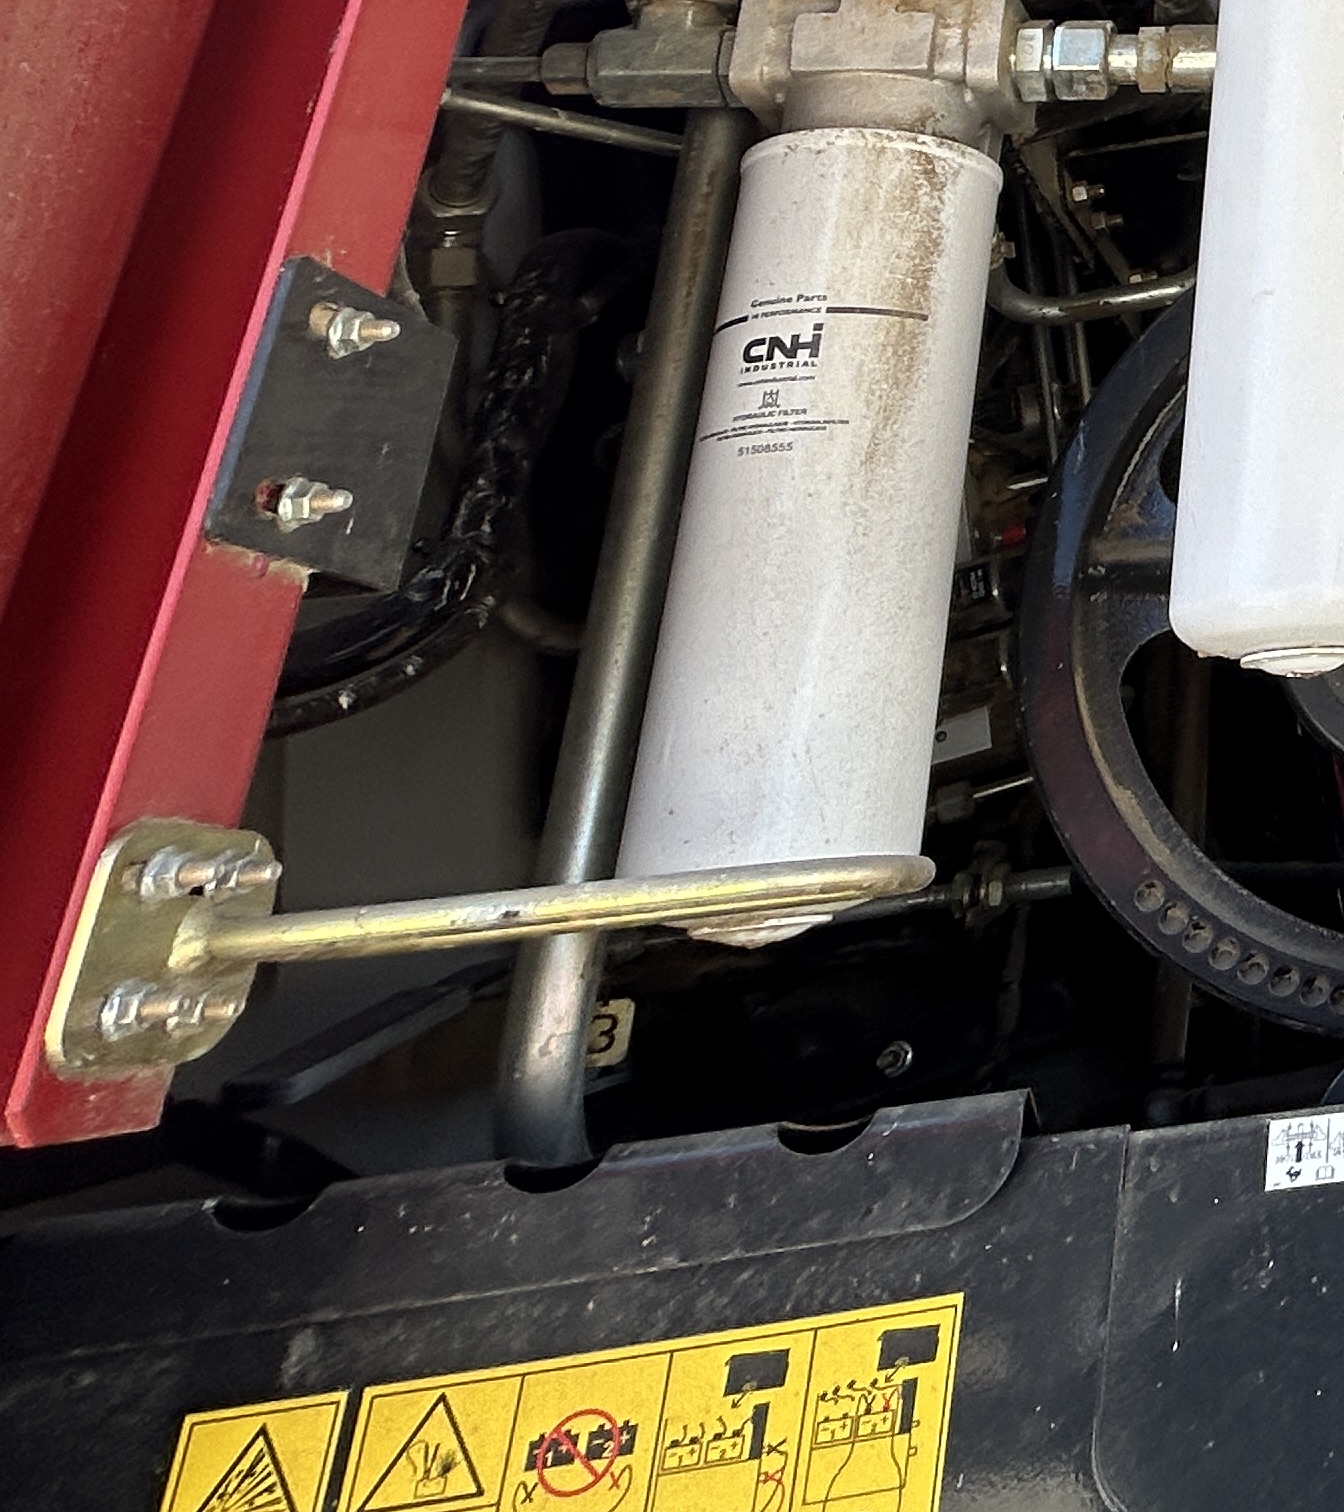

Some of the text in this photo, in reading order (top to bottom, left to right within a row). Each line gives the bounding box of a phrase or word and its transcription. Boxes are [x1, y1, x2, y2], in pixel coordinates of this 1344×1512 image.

[750, 294, 828, 308] Genuine Parts
[739, 360, 818, 374] INDUSTRIAL
